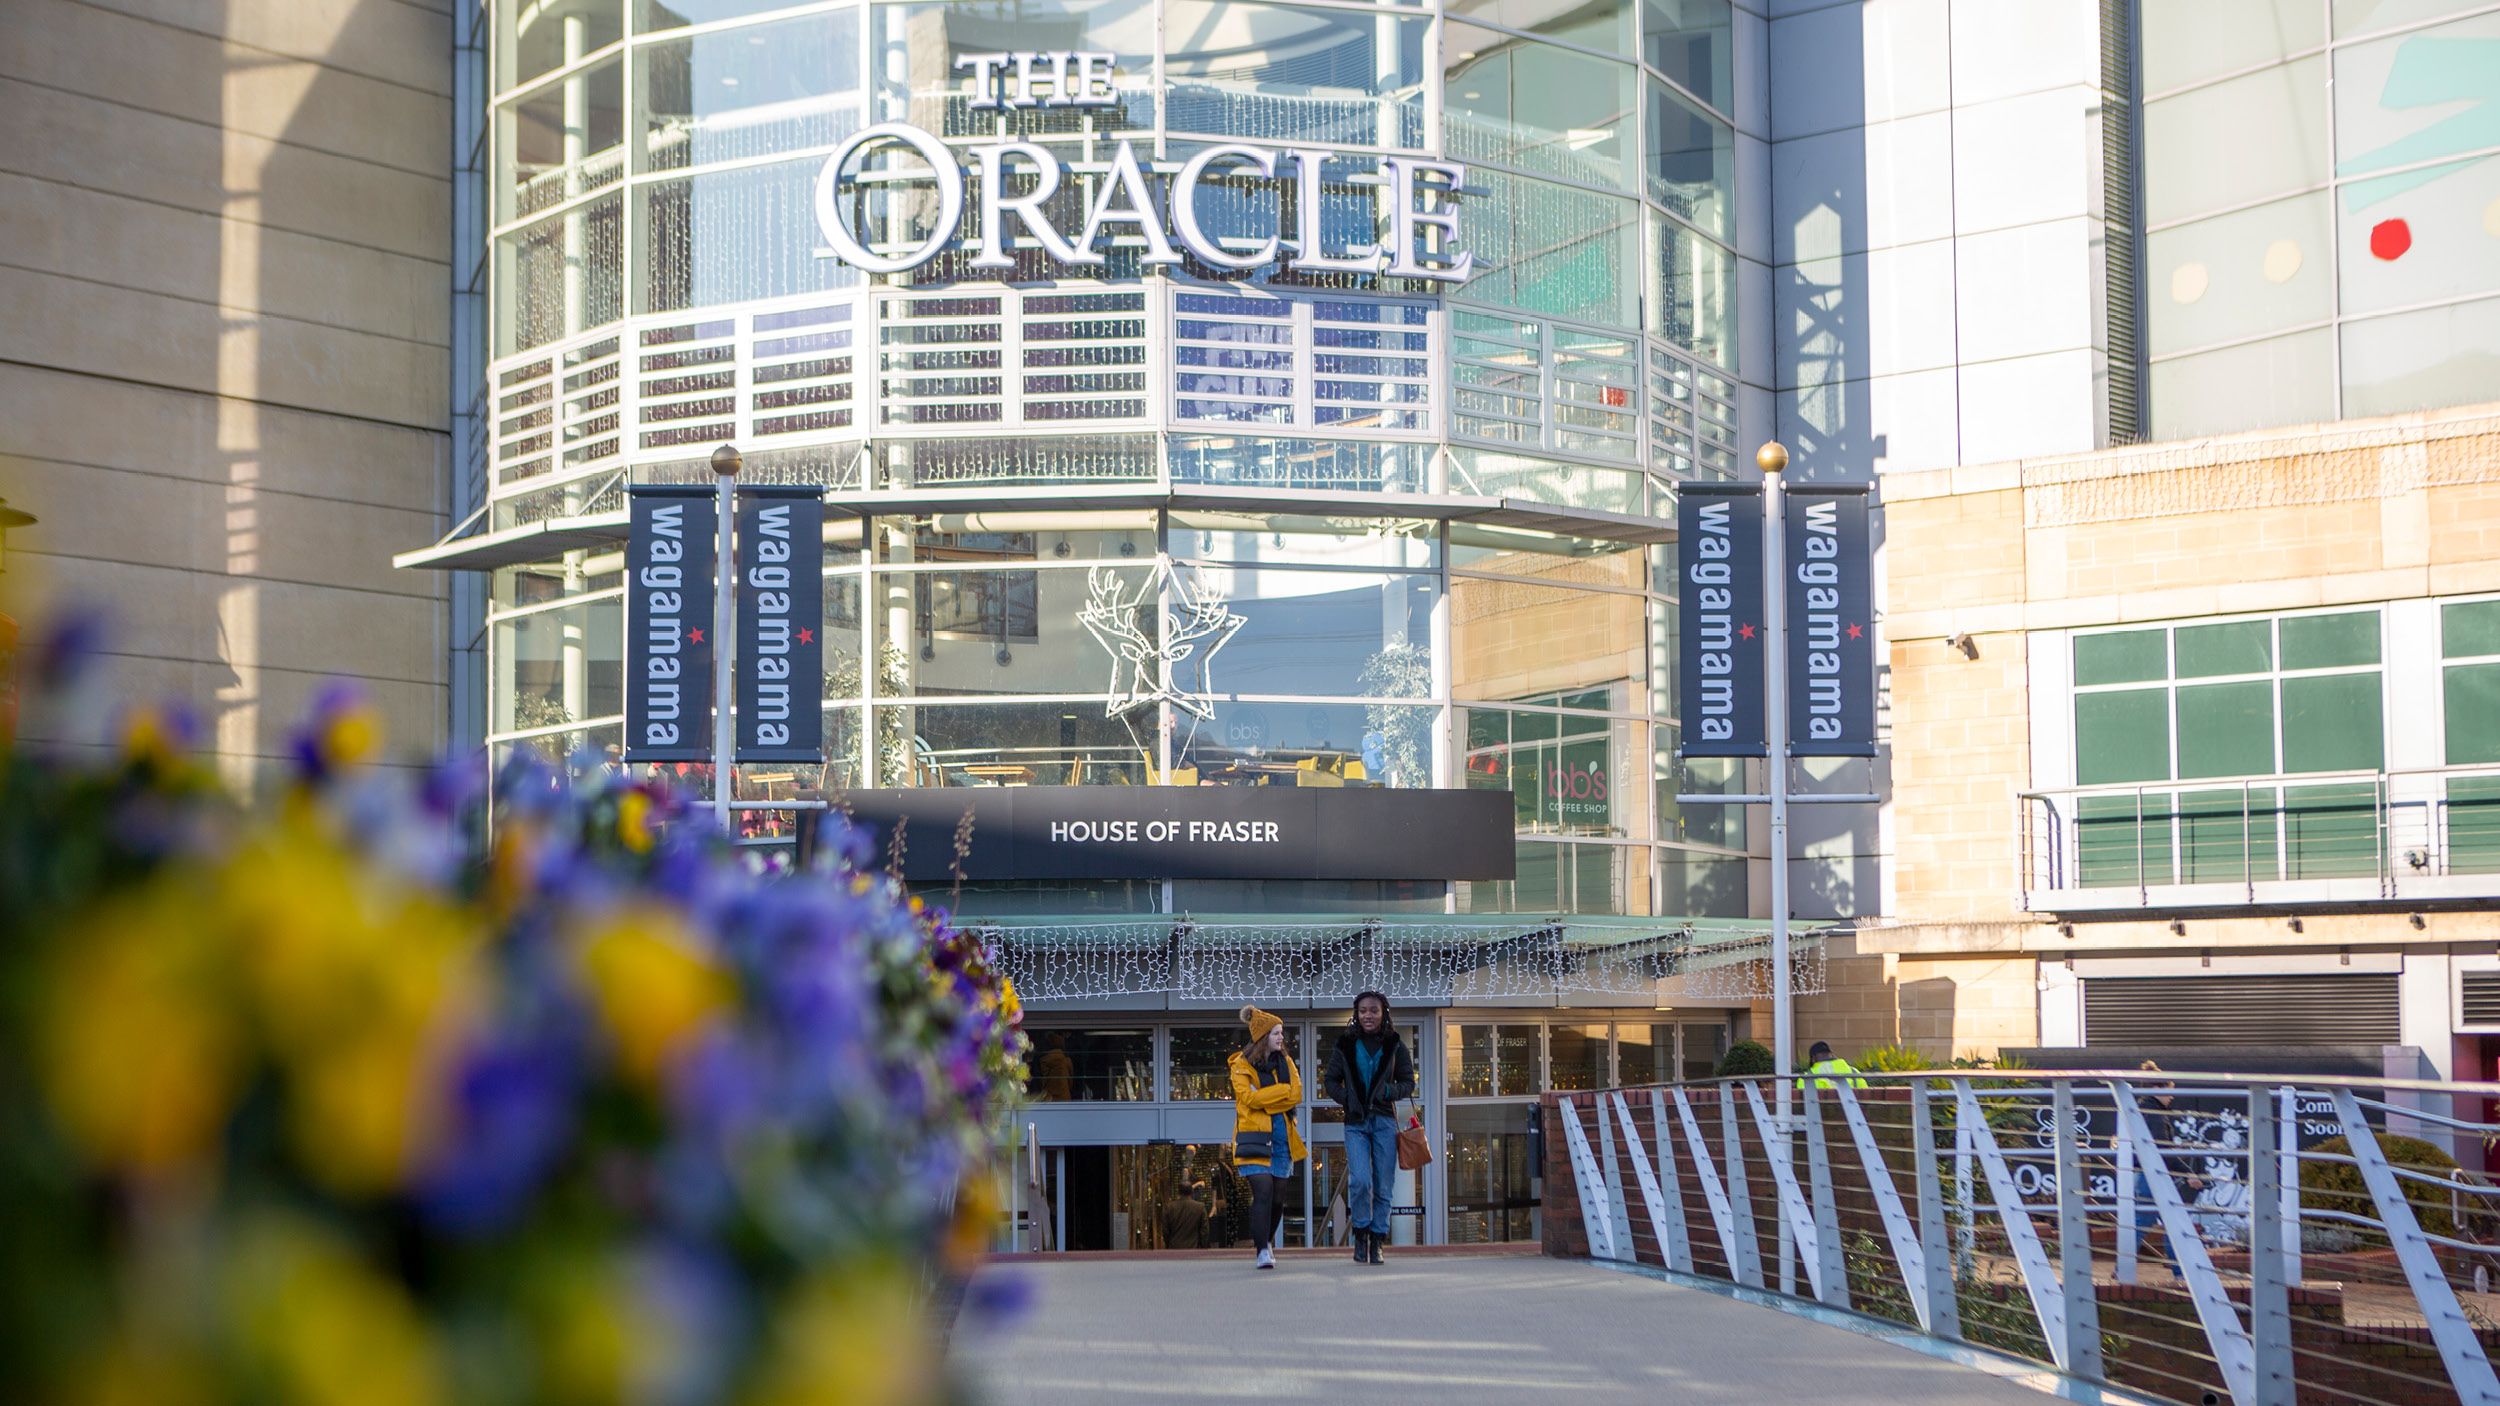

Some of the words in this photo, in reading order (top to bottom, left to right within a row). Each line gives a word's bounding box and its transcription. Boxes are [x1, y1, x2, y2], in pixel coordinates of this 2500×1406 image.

[954, 50, 1119, 109] THE
[814, 121, 1473, 283] ORACLE
[640, 504, 683, 745] wagamama
[749, 504, 791, 746] wagamama
[1690, 501, 1734, 740] wagamama
[1797, 501, 1842, 740] wagamama
[1051, 821, 1138, 842] HOUSE
[1146, 821, 1181, 842] OF
[1189, 821, 1280, 842] FRASER
[1548, 760, 1607, 800] bb's
[1548, 802, 1581, 813] COFFEE
[1583, 803, 1607, 813] SHOP
